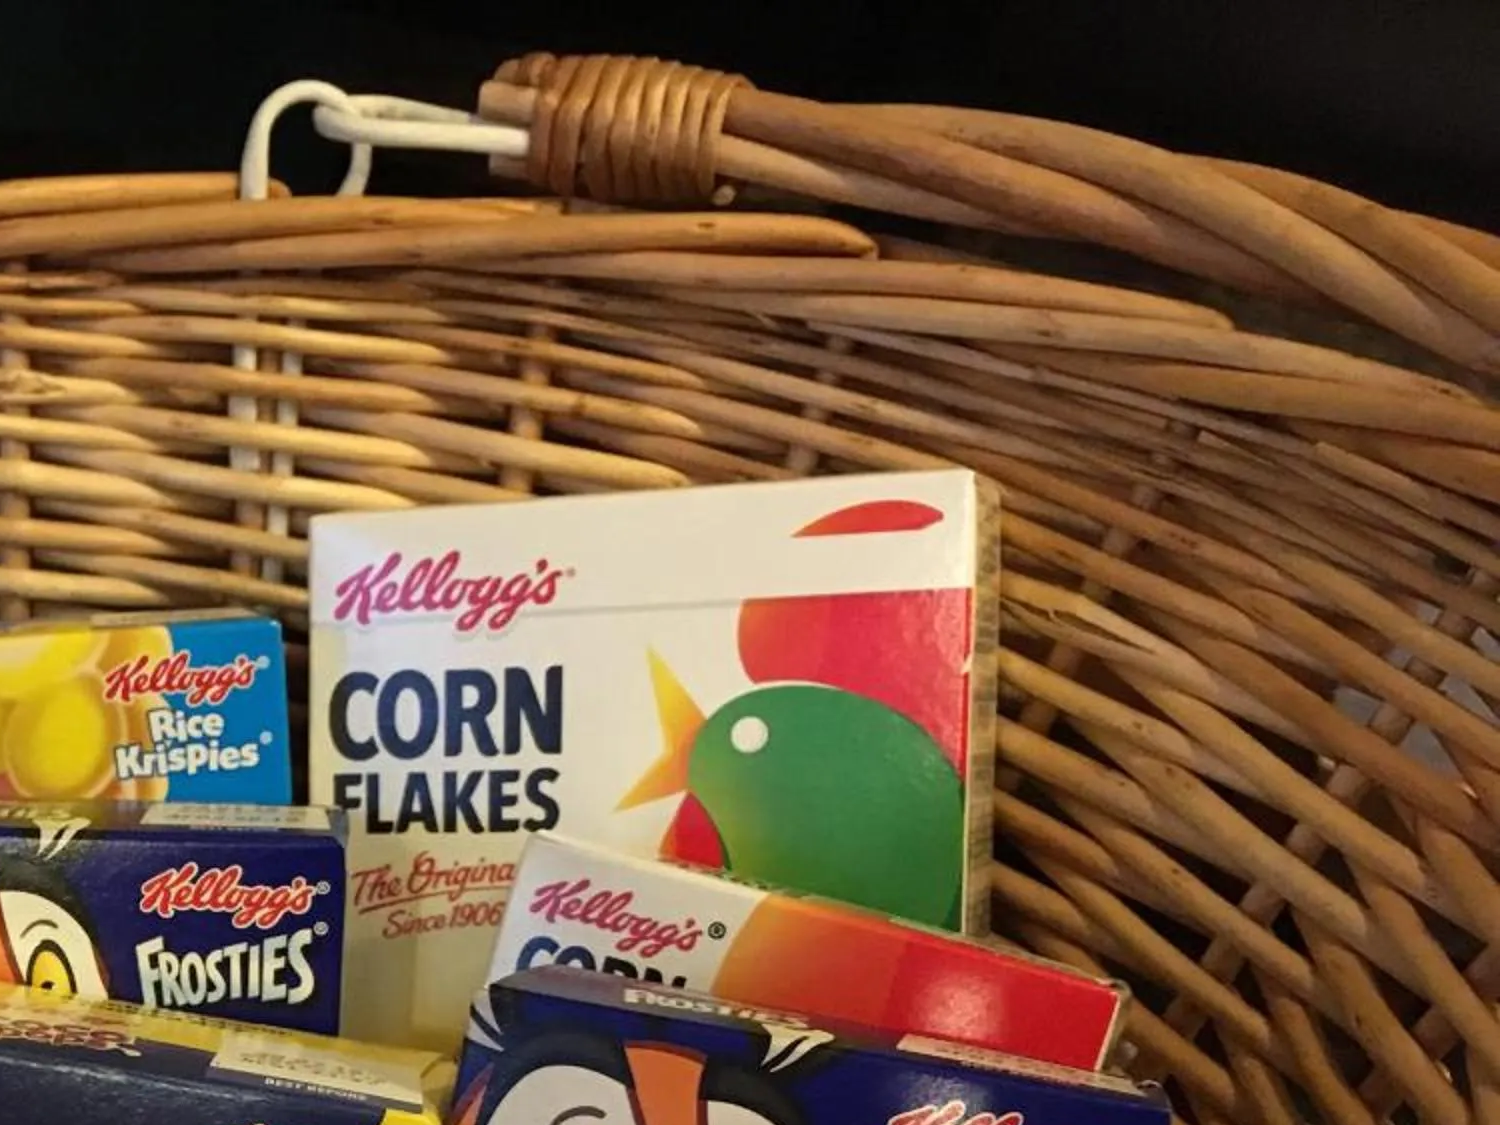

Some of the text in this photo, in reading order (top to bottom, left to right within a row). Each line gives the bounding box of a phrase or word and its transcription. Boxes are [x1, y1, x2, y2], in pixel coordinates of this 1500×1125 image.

[334, 549, 563, 632] Kellogg's
[103, 652, 256, 706] Kellogg's
[149, 709, 225, 743] Rice
[328, 665, 563, 762] CORN
[114, 740, 261, 780] Krispies
[333, 767, 561, 835] FLAKES
[140, 863, 314, 928] Kellogg's
[351, 851, 516, 907] The Origina
[381, 901, 504, 939] Since 1906
[529, 878, 703, 958] Kellogg's
[135, 927, 314, 1010] FROSTIES
